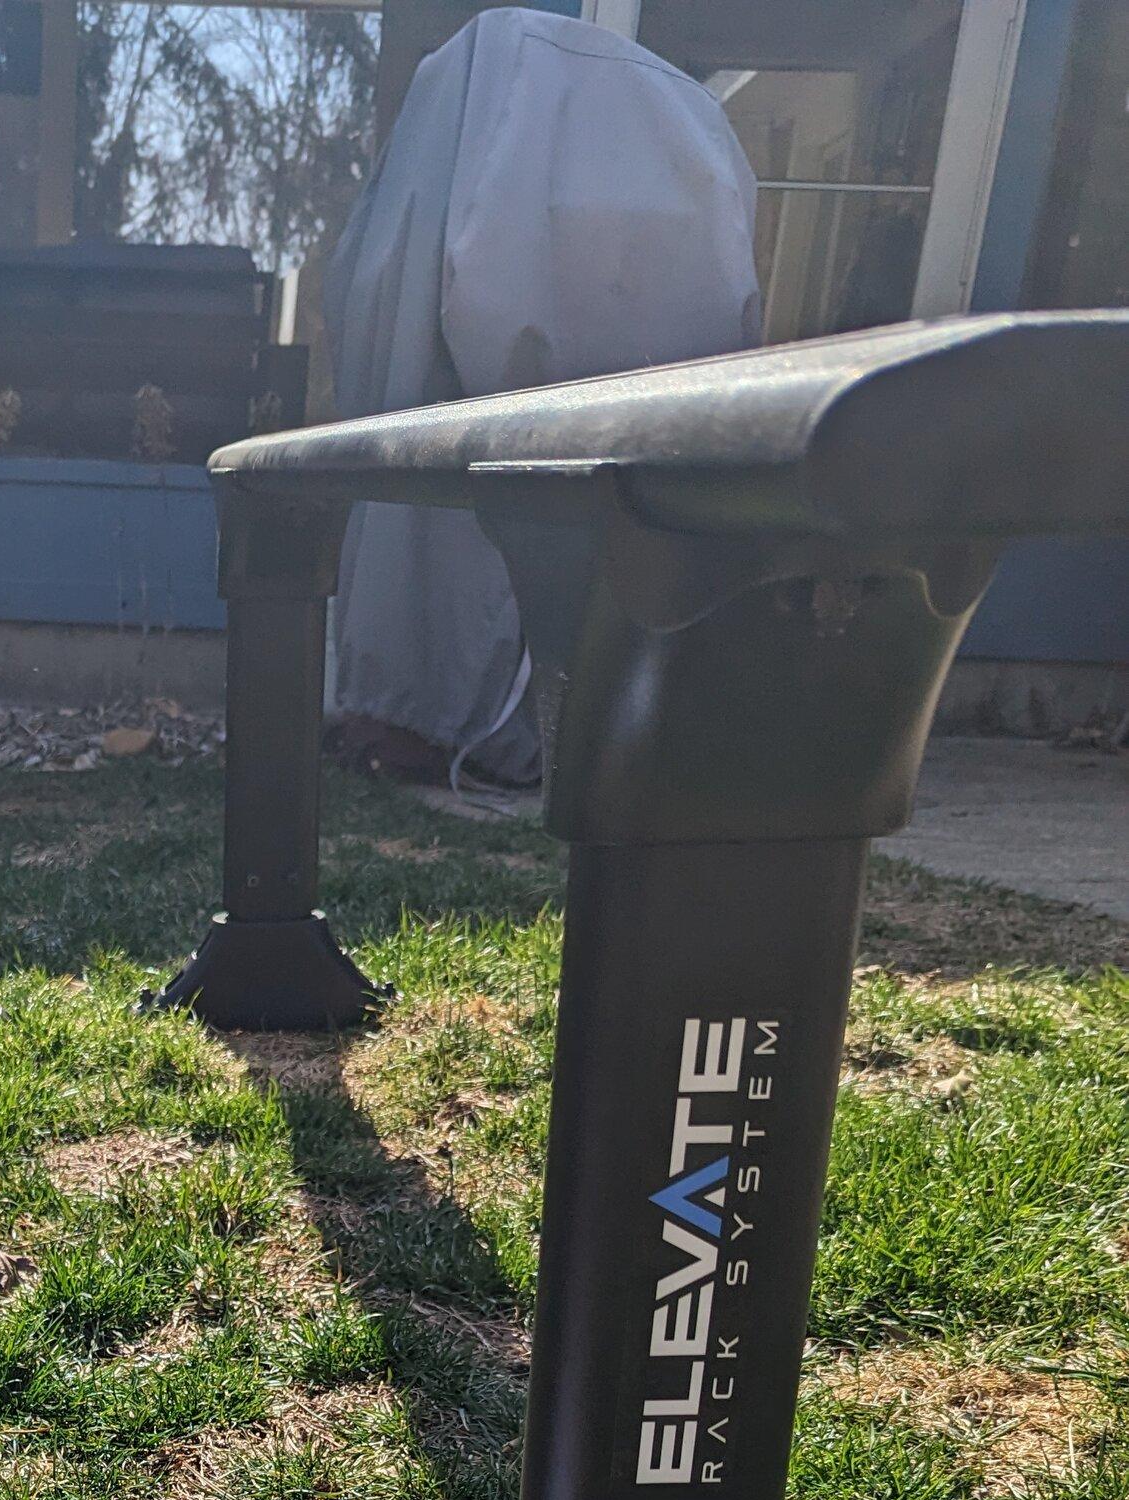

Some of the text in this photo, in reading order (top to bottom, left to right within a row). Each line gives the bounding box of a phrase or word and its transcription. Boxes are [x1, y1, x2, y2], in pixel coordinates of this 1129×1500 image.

[635, 1016, 747, 1485] ELEVATE
[700, 1020, 780, 1484] RACK SYSTEM
